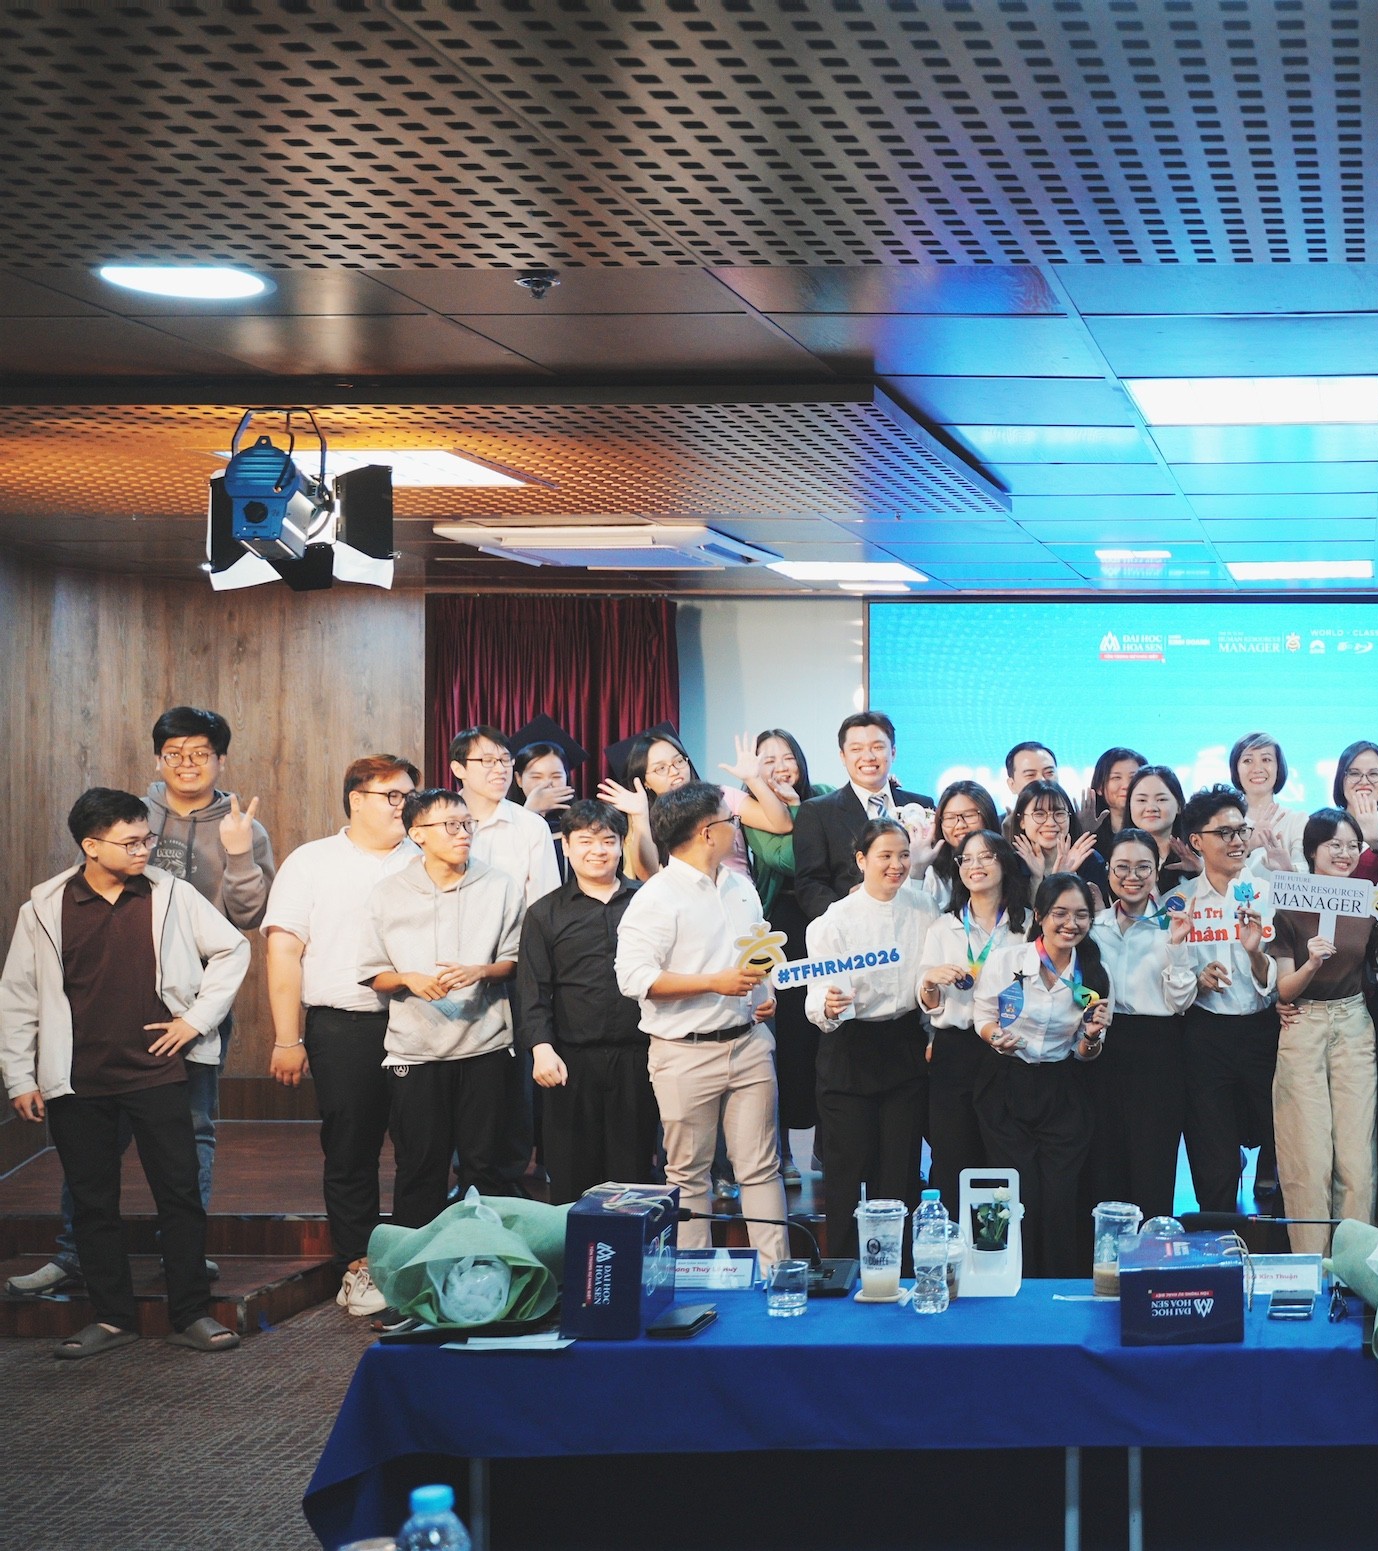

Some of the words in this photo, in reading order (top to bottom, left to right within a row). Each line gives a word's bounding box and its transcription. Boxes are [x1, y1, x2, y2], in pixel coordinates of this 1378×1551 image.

[1218, 643, 1280, 653] MANAGER
[1287, 875, 1311, 883] FUTURE
[1273, 881, 1308, 892] HUMAN
[1311, 885, 1364, 898] RESOURCES
[1272, 891, 1362, 914] MANAGER
[1185, 925, 1229, 943] hân
[777, 947, 901, 984] #TFHRM2026
[595, 1265, 603, 1285] HOA
[594, 1286, 602, 1304] SEN
[1170, 1299, 1191, 1307] HOA
[1151, 1300, 1169, 1308] SEN
